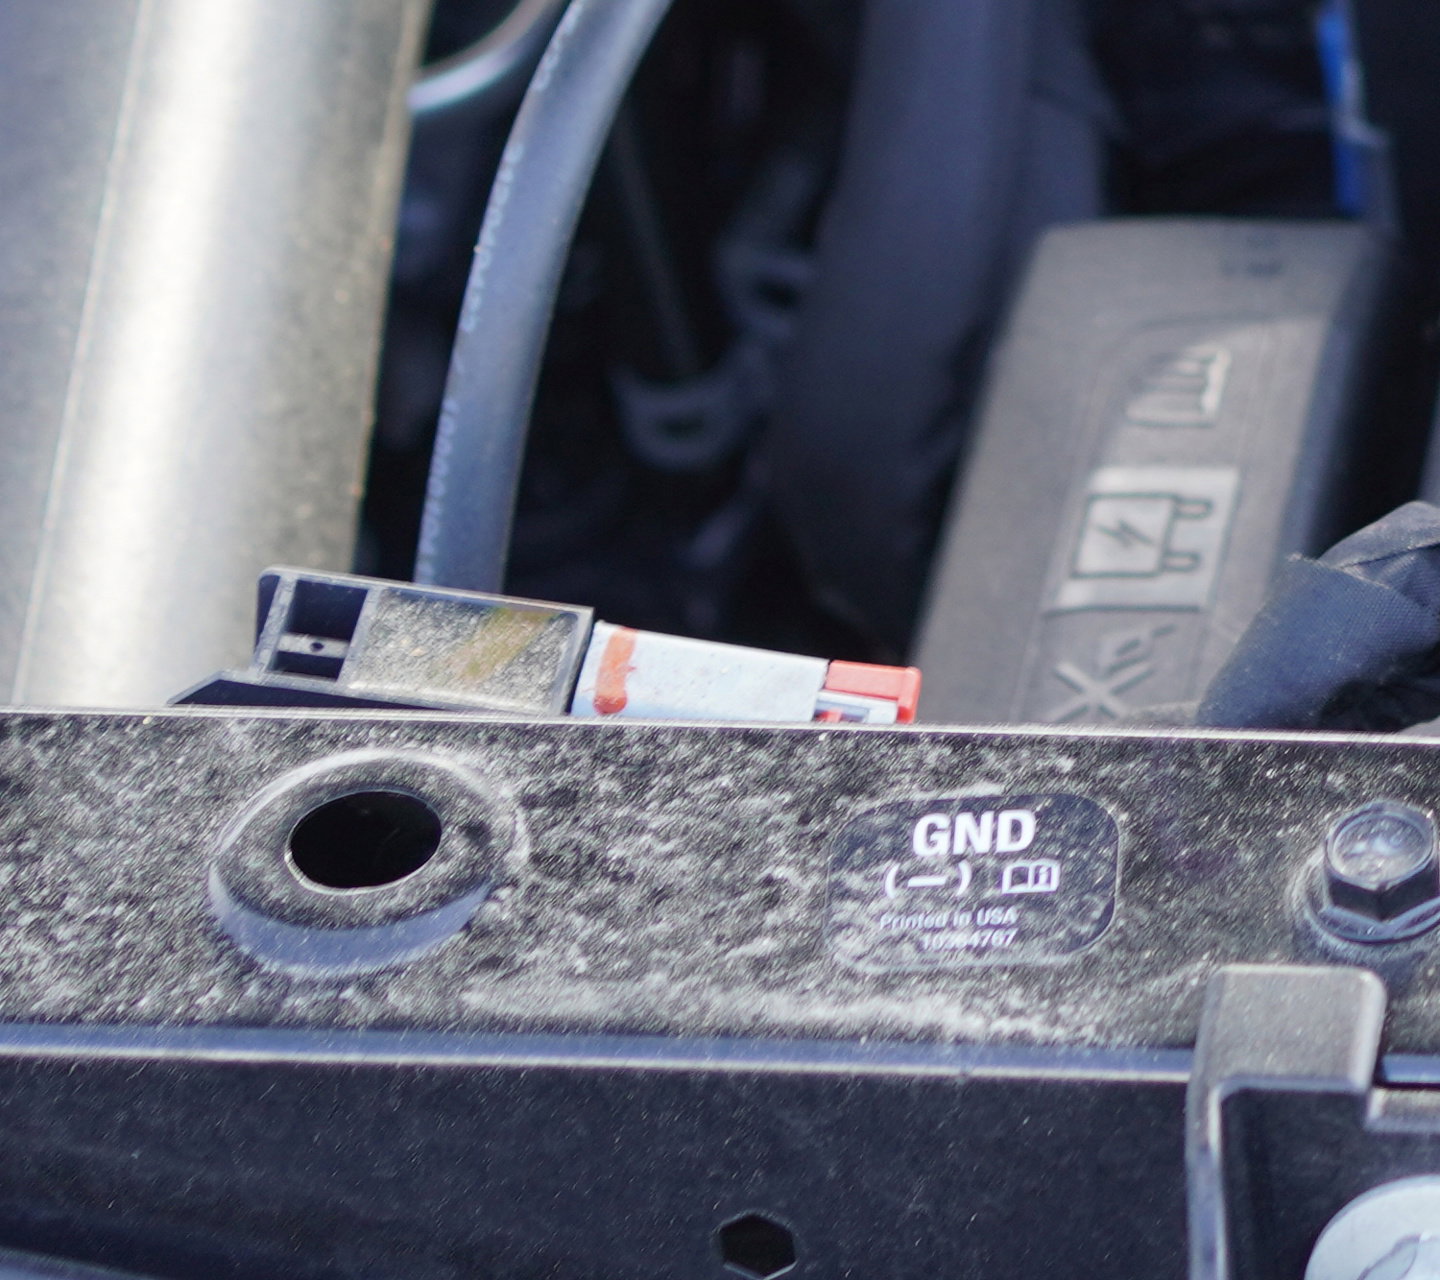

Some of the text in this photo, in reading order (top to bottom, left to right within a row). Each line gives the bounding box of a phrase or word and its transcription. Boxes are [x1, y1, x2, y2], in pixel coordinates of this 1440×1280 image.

[912, 809, 1036, 857] GND
[879, 905, 1019, 930] Printed in USA
